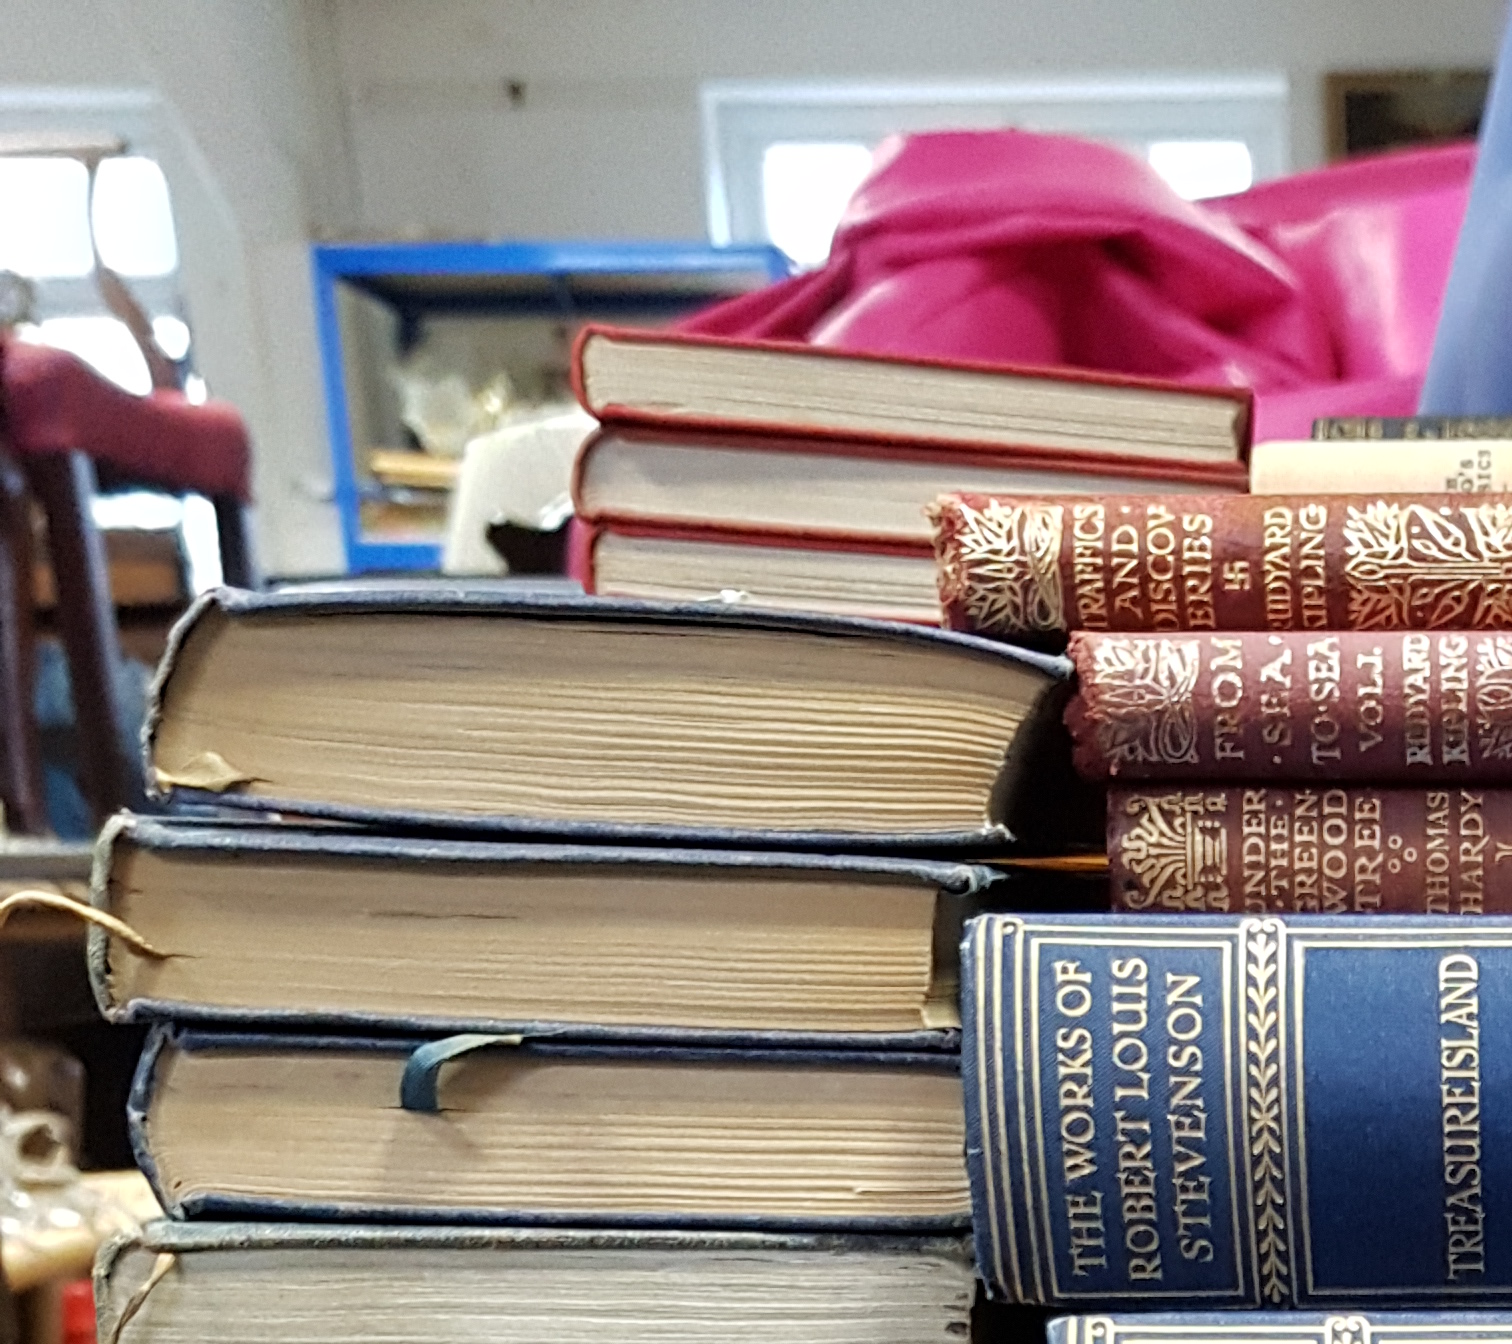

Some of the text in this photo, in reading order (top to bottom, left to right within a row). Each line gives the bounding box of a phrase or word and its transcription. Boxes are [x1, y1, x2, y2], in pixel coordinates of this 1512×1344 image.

[1111, 524, 1143, 618] AND
[1181, 513, 1214, 627] ERIES
[1211, 637, 1244, 760] FROM
[1402, 635, 1433, 766] RUDYARD
[1440, 636, 1470, 766] KIPLING
[1323, 789, 1347, 913] WOOD
[1354, 797, 1383, 911] TREE
[1427, 792, 1450, 913] THOMAS
[1459, 789, 1489, 915] HARDY
[1054, 961, 1107, 1276] THE WORKS OF
[1112, 958, 1162, 1280] ROBERT LOUIS
[1166, 972, 1214, 1262] STEVENSON
